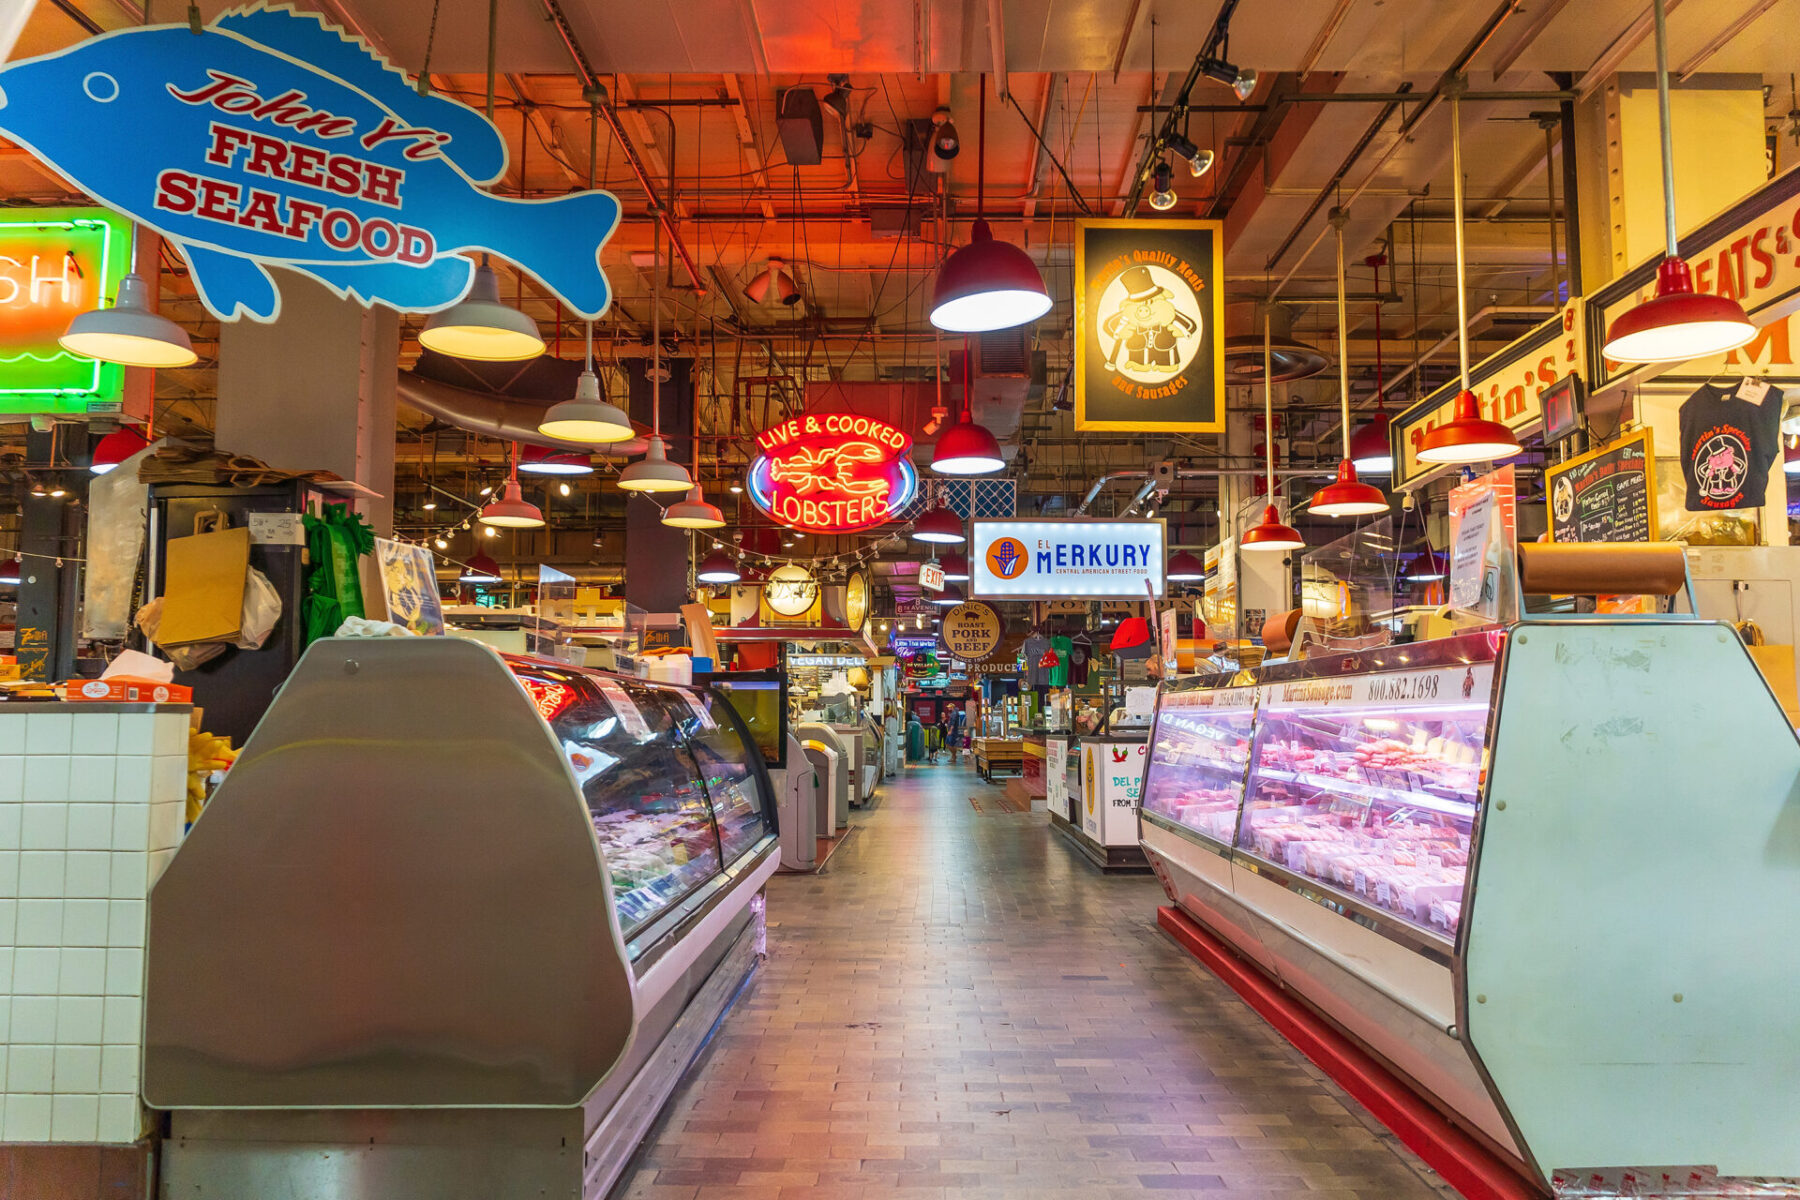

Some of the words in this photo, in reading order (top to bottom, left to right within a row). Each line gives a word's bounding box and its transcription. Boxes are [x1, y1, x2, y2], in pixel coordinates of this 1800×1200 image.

[166, 69, 357, 139] John
[360, 115, 452, 160] Yi
[206, 123, 405, 209] FRESH
[154, 169, 436, 268] SEAFOOD
[1133, 249, 1178, 267] Quality
[1175, 260, 1206, 293] Meats
[1690, 227, 1775, 301] EATS
[1111, 374, 1134, 397] and
[1136, 374, 1189, 400] Sausages
[757, 420, 800, 449] LIVE
[805, 416, 822, 433] &
[825, 415, 906, 449] COOKED
[772, 489, 890, 527] LOBSTERS
[1037, 539, 1051, 549] EL
[1036, 543, 1151, 574] MERKURY
[925, 567, 942, 587] EXIT
[952, 603, 990, 617] DINIC'S
[952, 629, 991, 639] PORK
[954, 642, 991, 652] BEEF
[789, 656, 834, 666] VEGAN
[955, 654, 973, 664] SINCE
[967, 663, 1017, 672] PRODUCE
[1368, 674, 1440, 701] 800.882.1698
[1112, 776, 1131, 787] DEL
[1112, 799, 1131, 808] FROM
